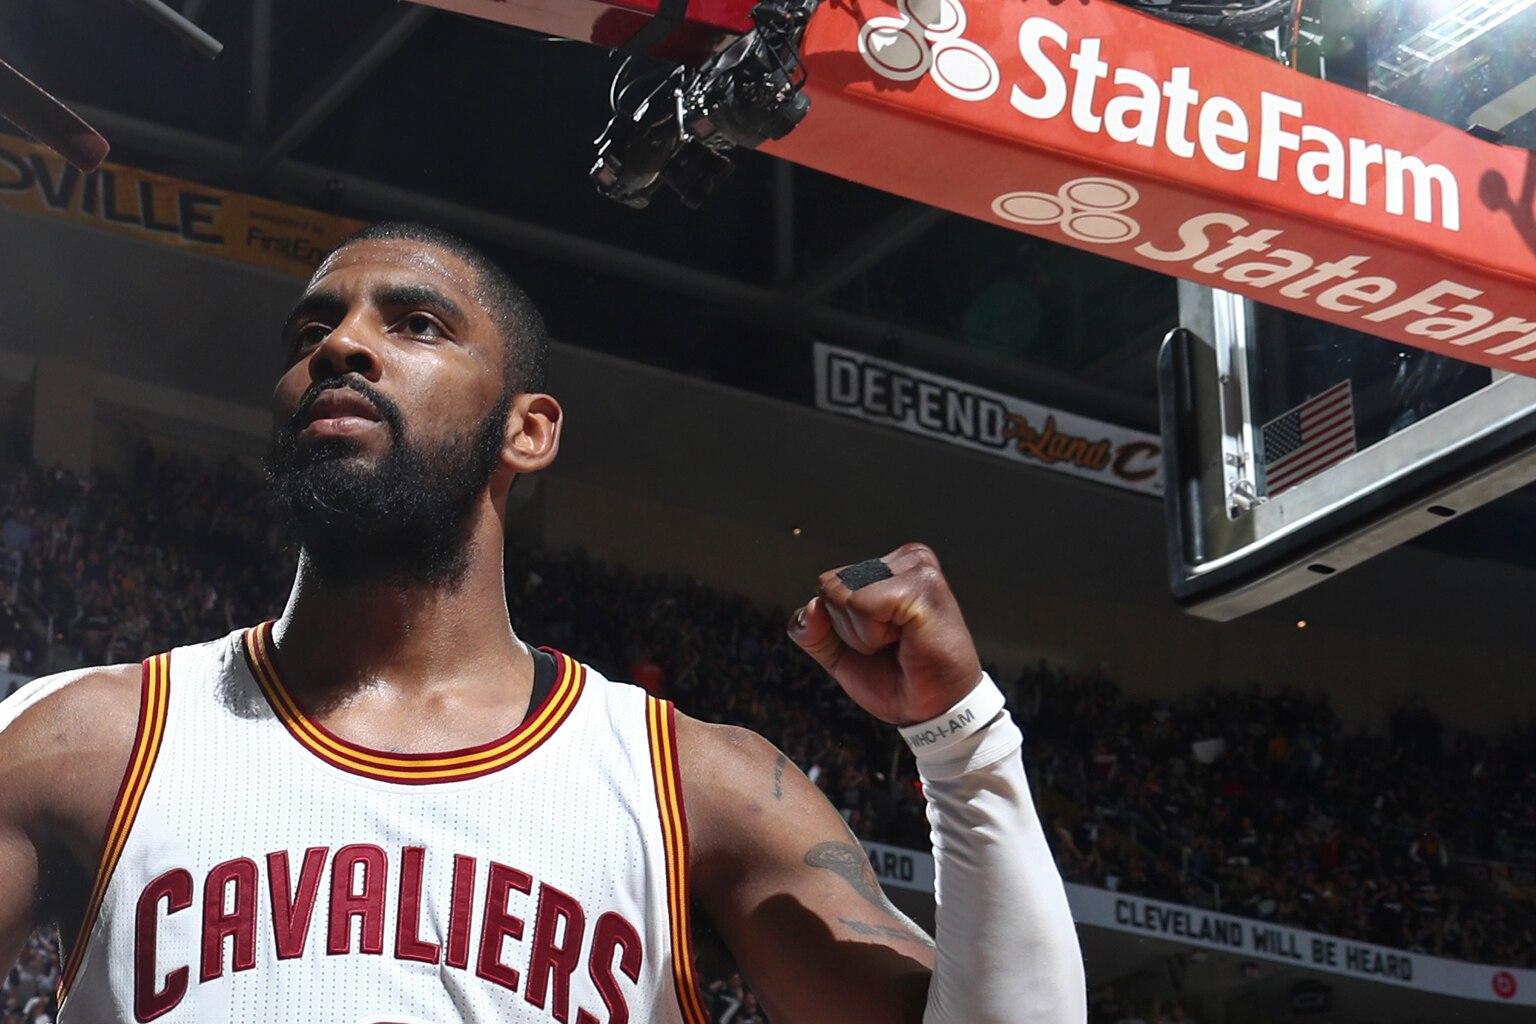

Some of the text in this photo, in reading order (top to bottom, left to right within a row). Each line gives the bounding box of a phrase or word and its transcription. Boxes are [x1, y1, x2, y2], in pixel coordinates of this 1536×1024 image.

[1010, 16, 1461, 232] StateFarm
[827, 354, 1007, 449] DEFEND
[868, 849, 915, 882] ARD
[1115, 899, 1414, 982] CLEVELAND WILL BE HEARD
